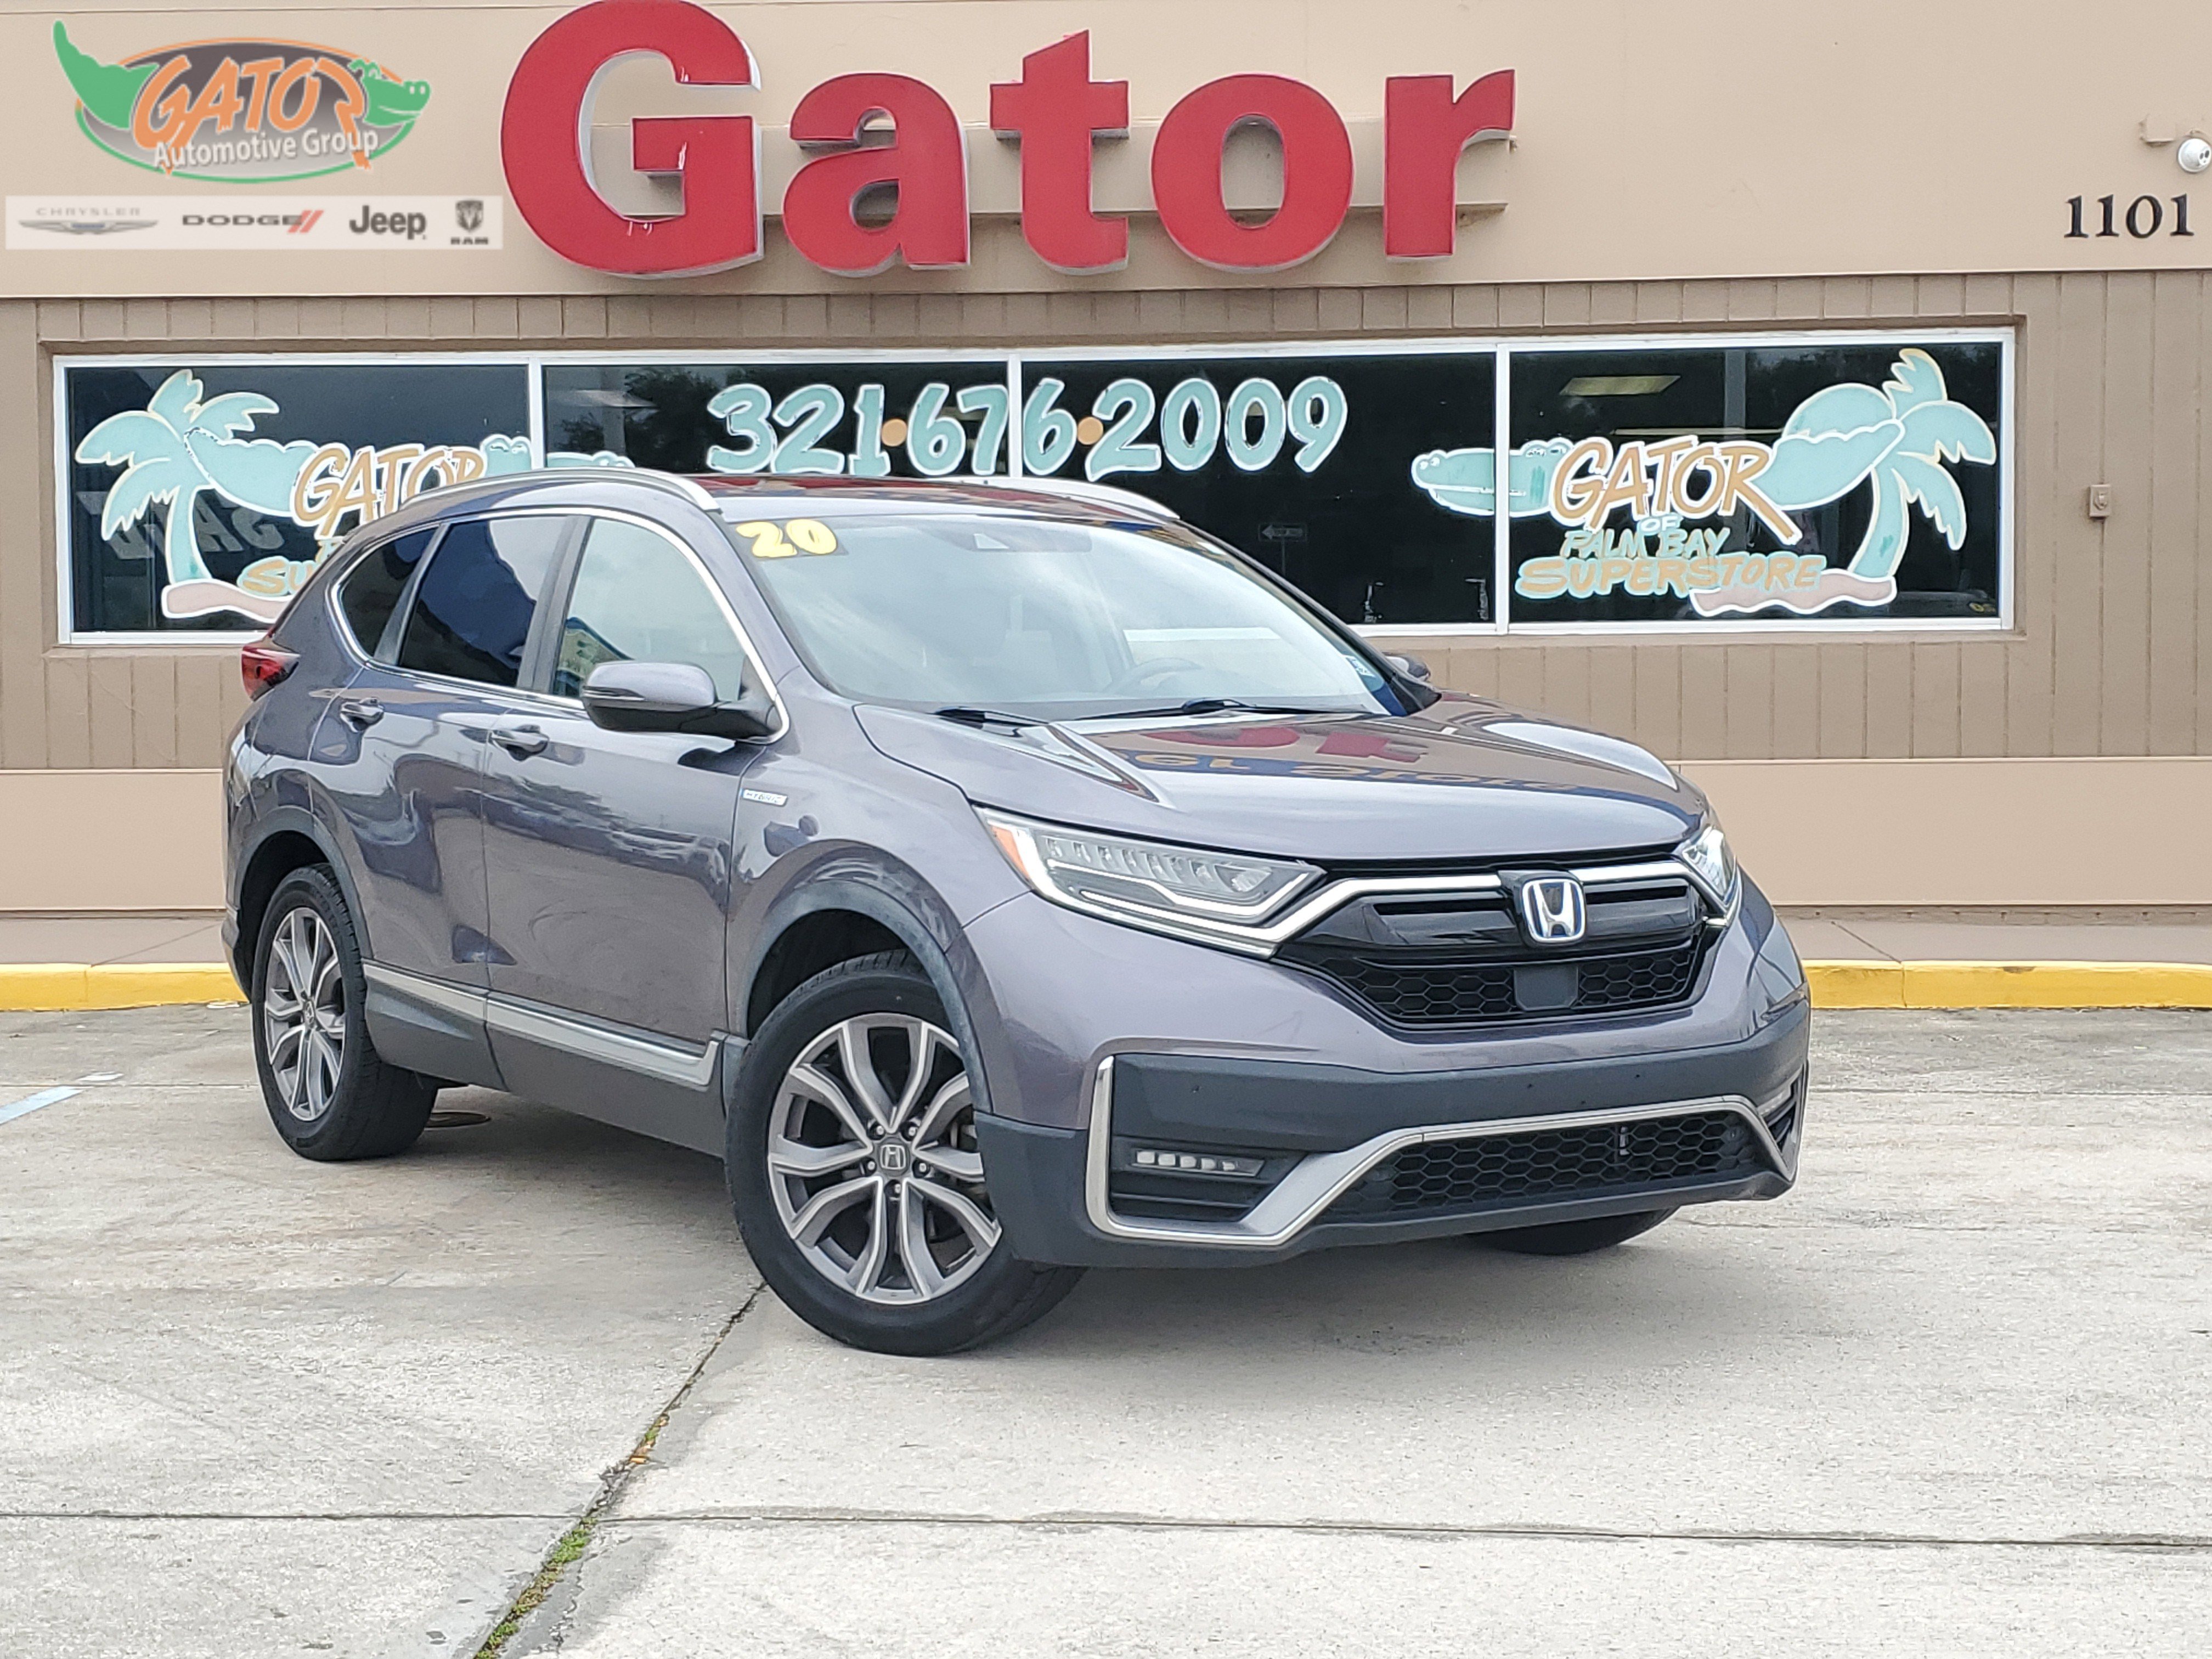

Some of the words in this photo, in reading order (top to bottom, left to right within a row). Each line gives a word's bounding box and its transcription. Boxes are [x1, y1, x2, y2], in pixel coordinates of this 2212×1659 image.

[501, 0, 1516, 280] Gator
[2063, 193, 2194, 239] 1101
[1549, 435, 1802, 545] GATOR
[735, 518, 838, 558] 20
[1560, 527, 1646, 558] PALM
[1654, 527, 1730, 558] BAY
[1639, 514, 1683, 535] OF
[1515, 552, 1826, 599] SUPERSTORE
